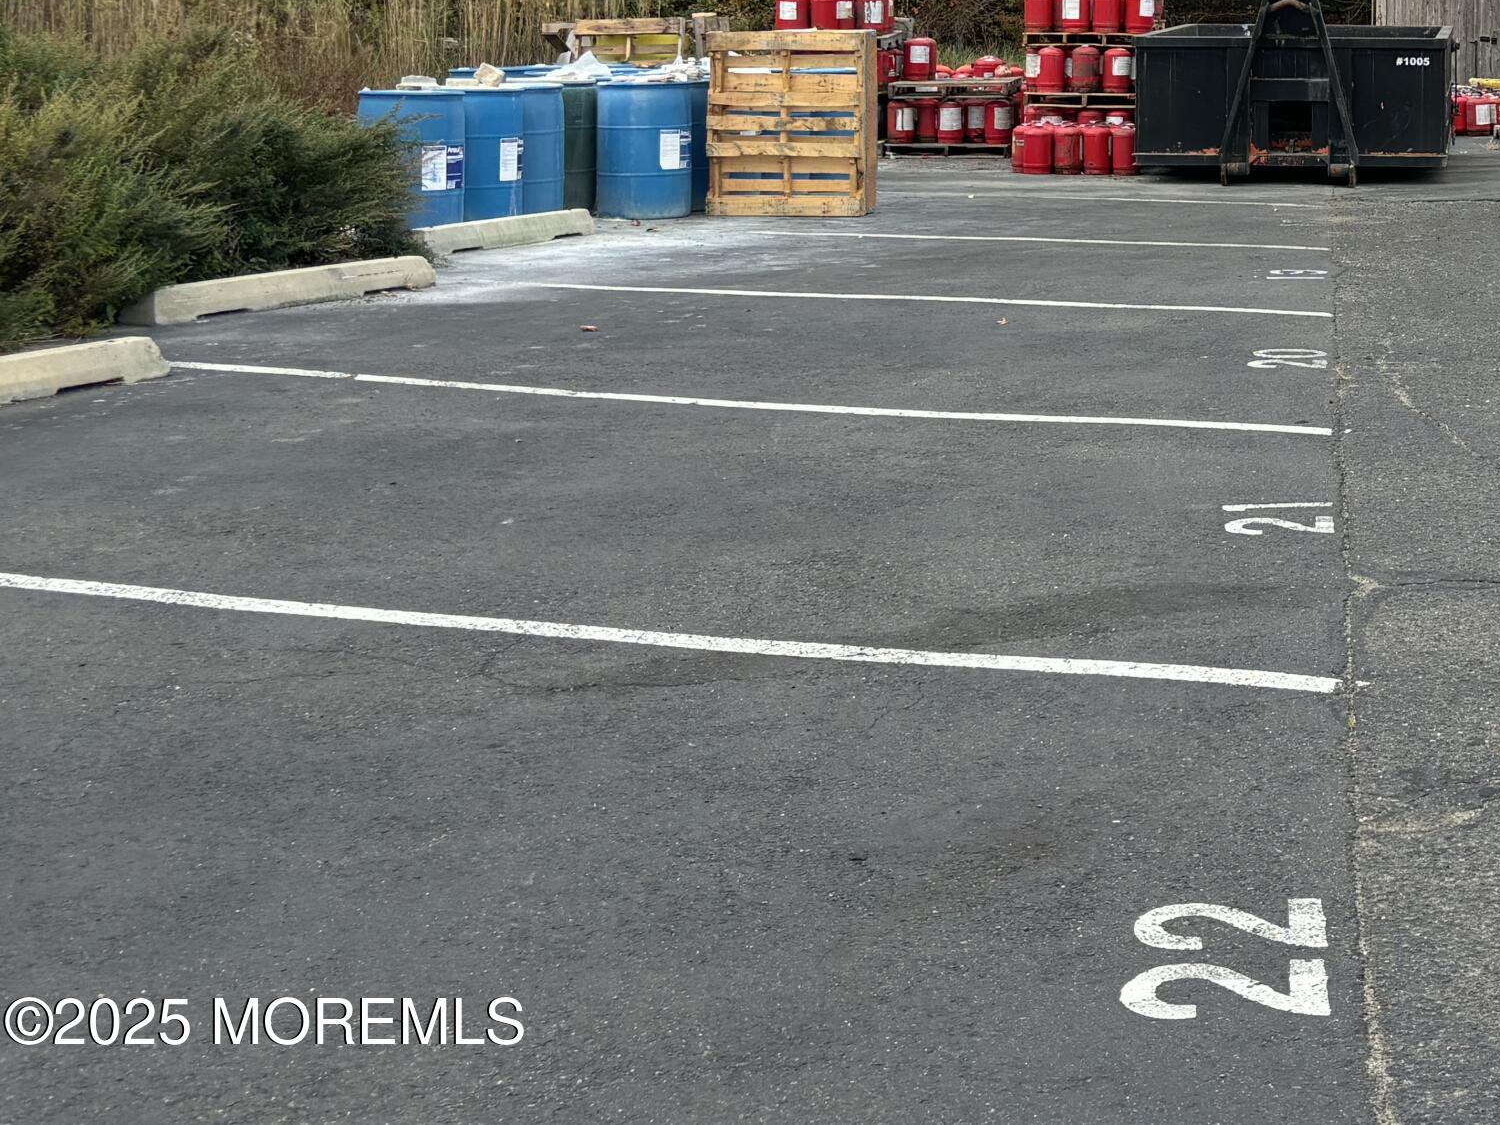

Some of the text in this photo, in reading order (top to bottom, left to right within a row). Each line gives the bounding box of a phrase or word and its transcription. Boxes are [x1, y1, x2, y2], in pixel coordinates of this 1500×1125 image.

[1395, 56, 1431, 67] #1005
[1246, 347, 1329, 369] 20
[1221, 501, 1336, 536] 21
[1119, 897, 1332, 1020] 22
